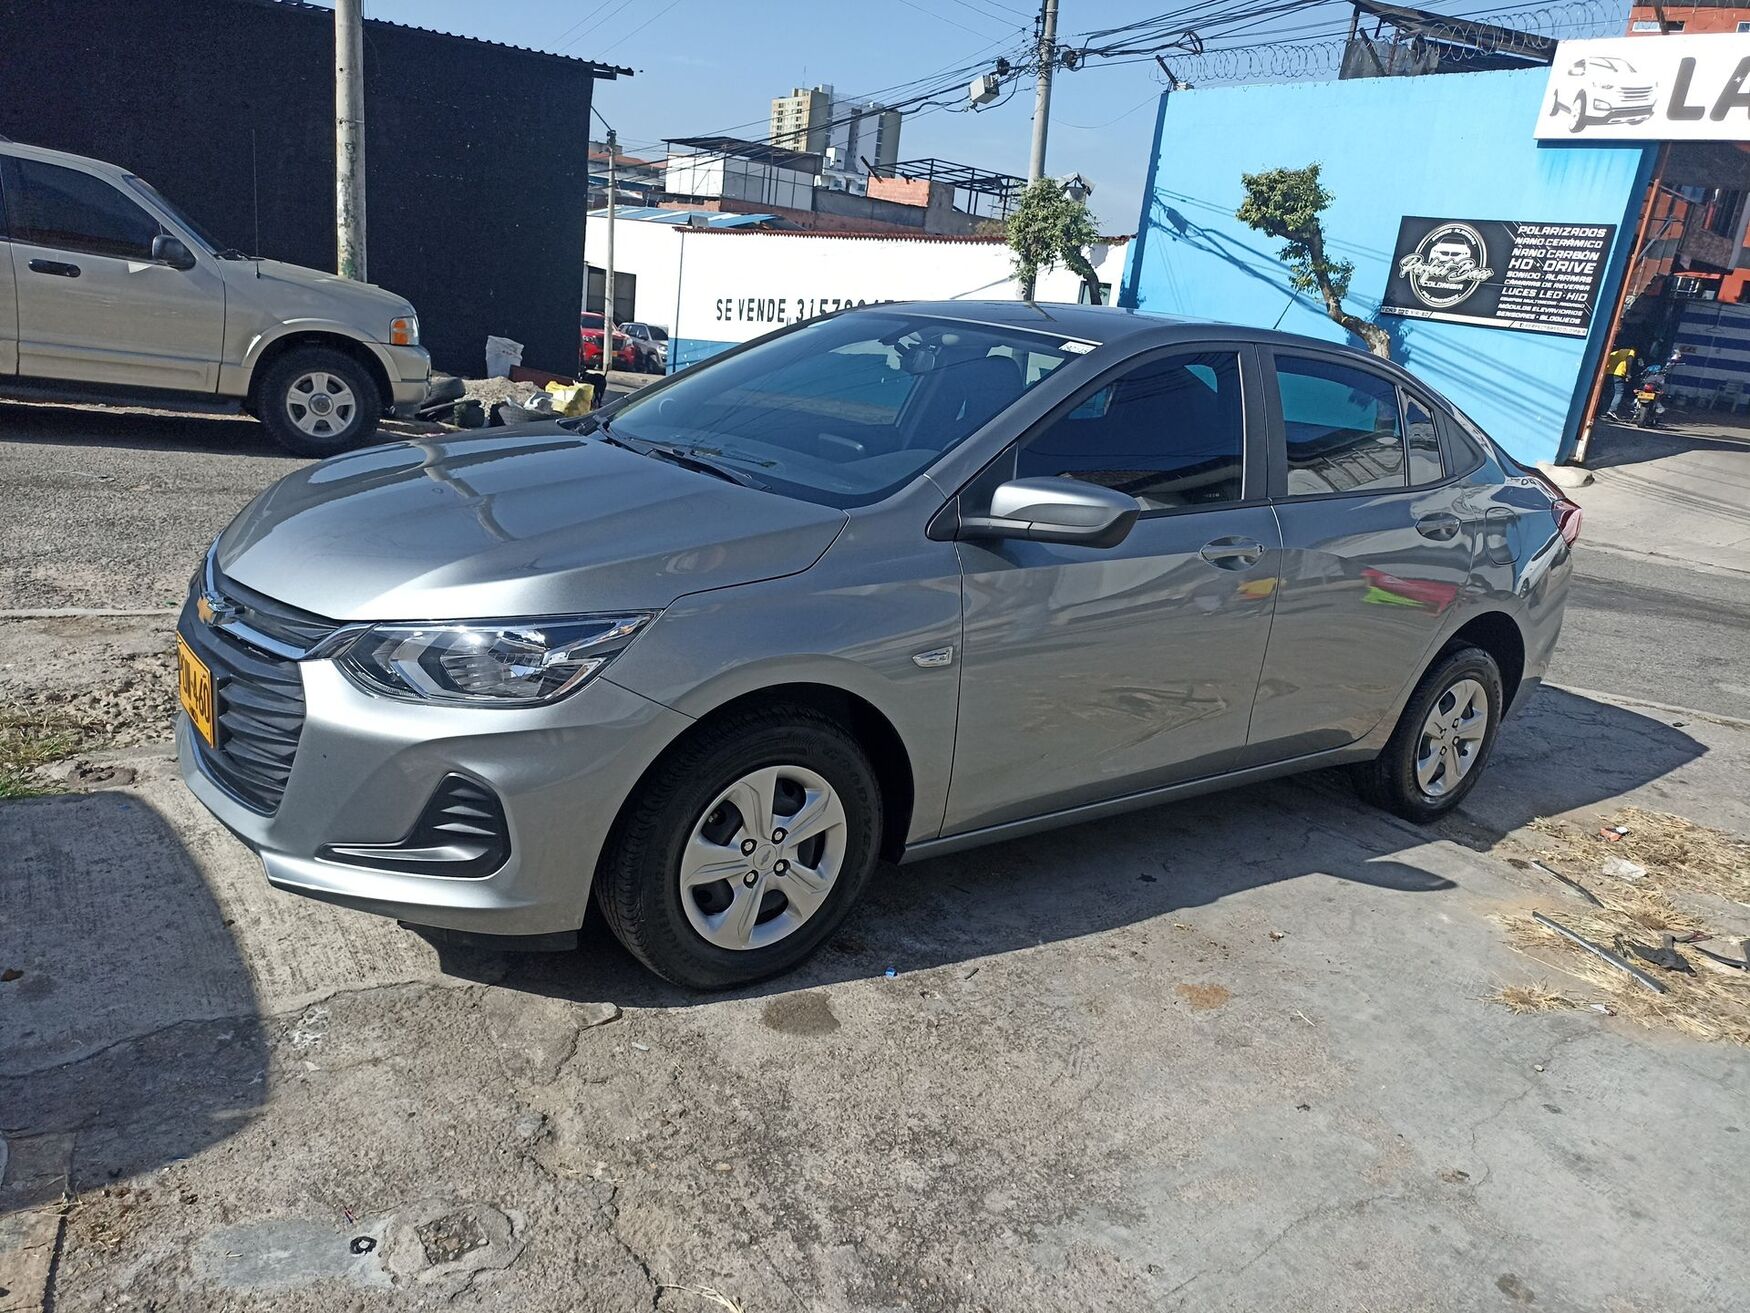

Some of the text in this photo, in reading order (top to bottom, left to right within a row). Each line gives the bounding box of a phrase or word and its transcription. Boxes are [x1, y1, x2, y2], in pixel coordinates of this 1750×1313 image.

[1517, 226, 1607, 238] POLARIZADOS
[1514, 237, 1604, 249] NANO CERÁMICO
[1511, 247, 1600, 261] NANO CARBÓN
[1400, 254, 1494, 284] Perfect Bass
[1508, 258, 1597, 274] HD DRIVE
[1506, 271, 1593, 284] SONIDO ALARMAS
[1422, 280, 1463, 290] COLOMBIA
[1501, 287, 1589, 302] LUCES LED HID
[716, 298, 732, 321] SE
[738, 298, 786, 323] VENDE
[1539, 314, 1581, 324] BLOQUEOS
